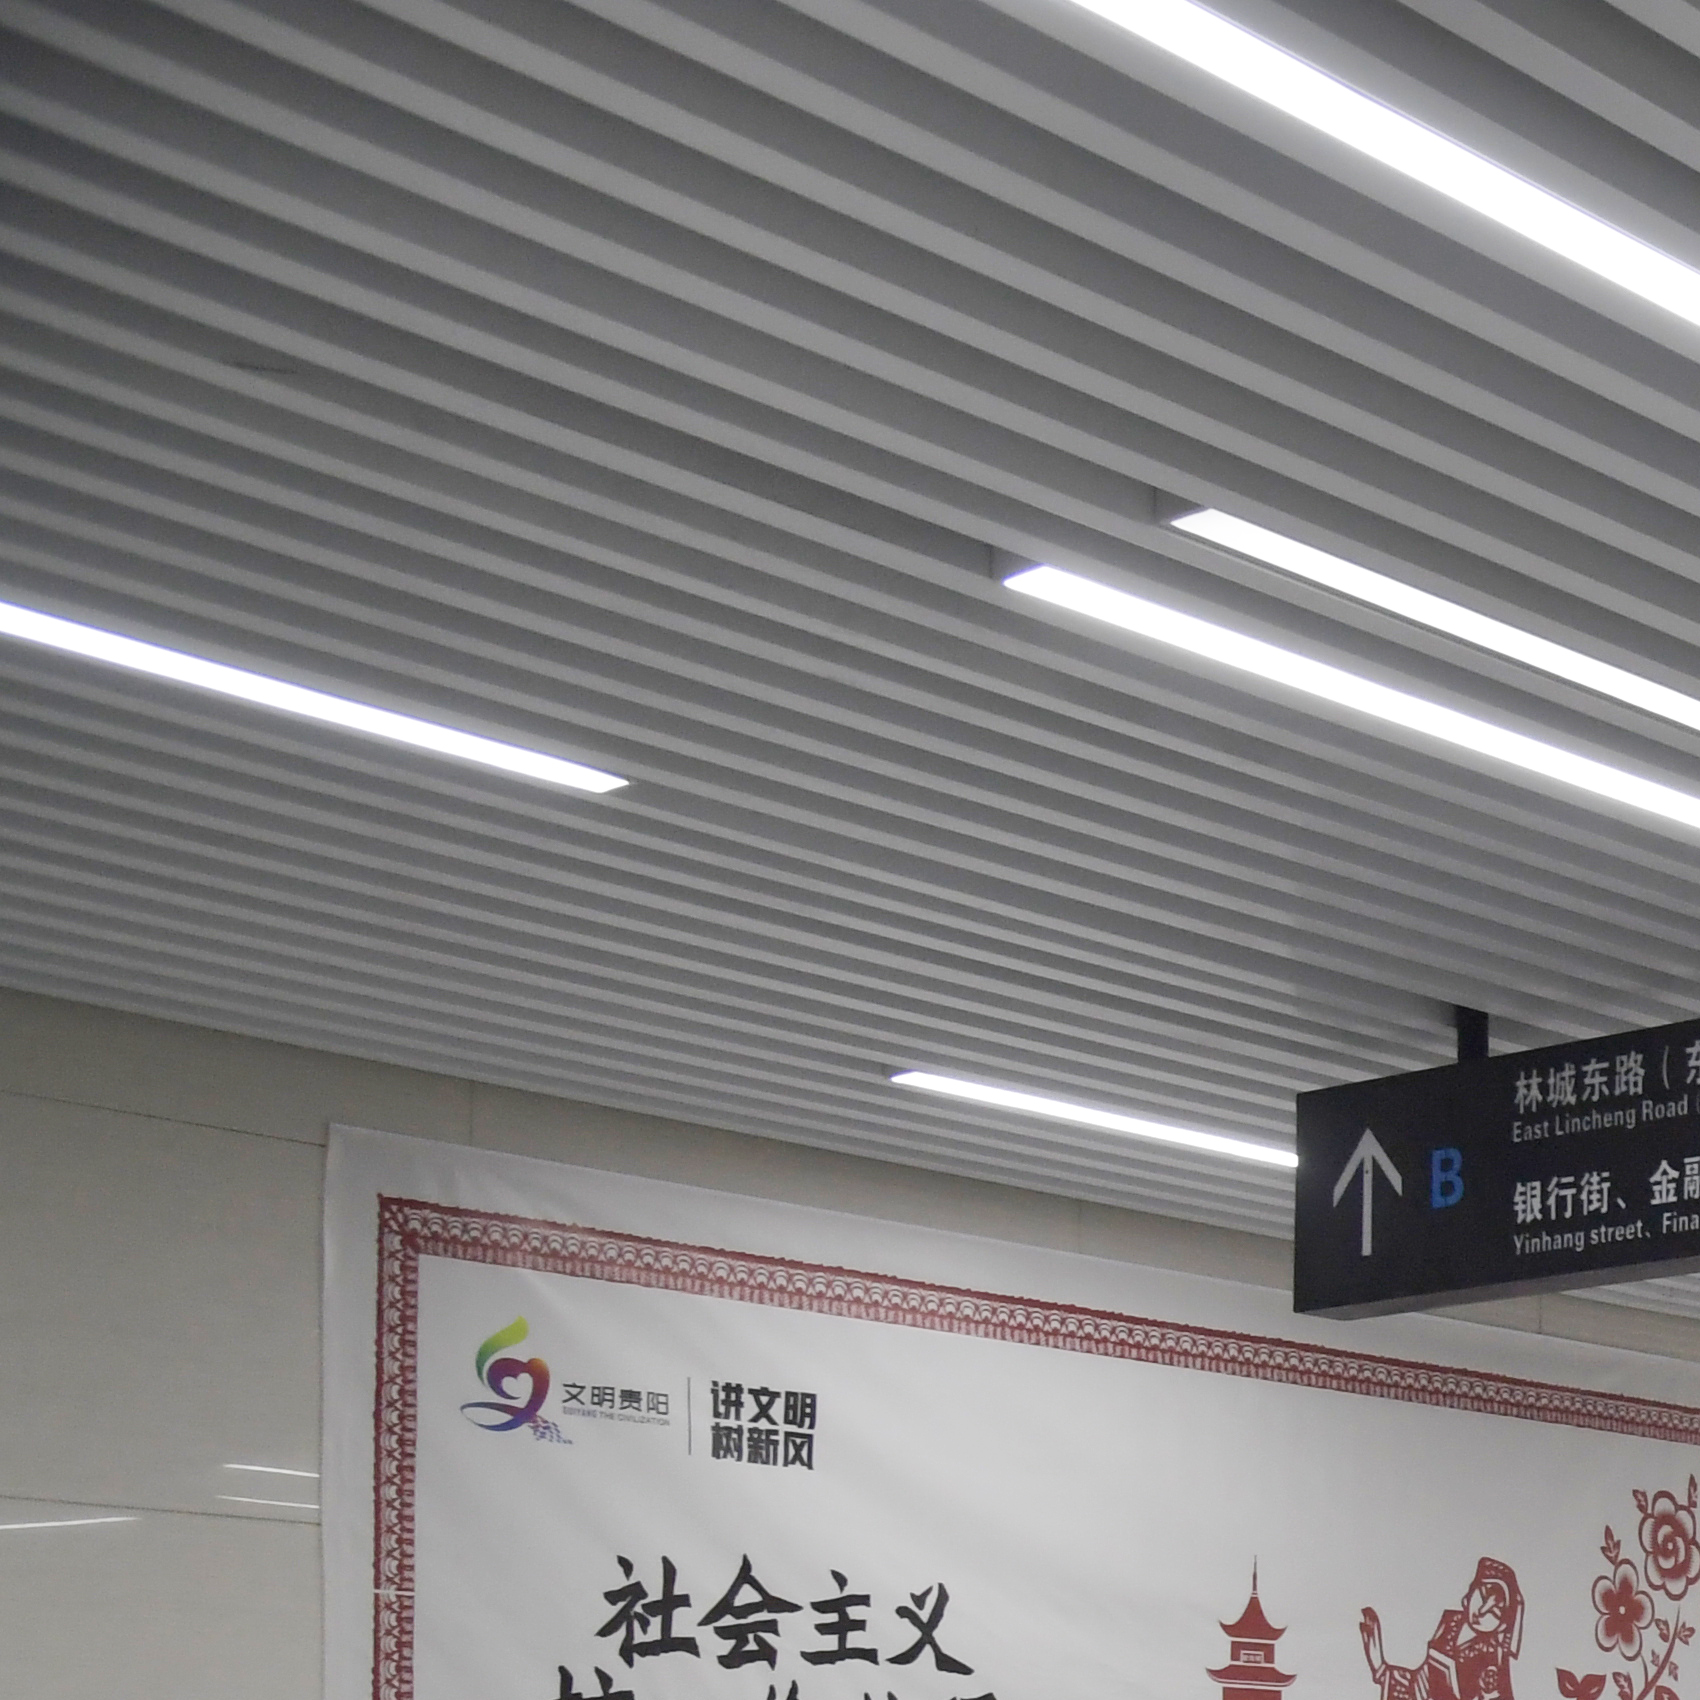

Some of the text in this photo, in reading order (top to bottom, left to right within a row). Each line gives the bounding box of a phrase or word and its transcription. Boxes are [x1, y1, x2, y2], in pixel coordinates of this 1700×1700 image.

[1512, 1119, 1549, 1143] East
[1555, 1108, 1637, 1137] Lincheng
[1642, 1095, 1689, 1122] Road
[1430, 1146, 1464, 1210] B
[1513, 1229, 1585, 1256] Yinhang
[562, 1382, 670, 1416] 文明贵阳
[710, 1379, 818, 1431] 讲文明
[710, 1422, 815, 1471] 树新风
[595, 1553, 975, 1676] 社会主义
